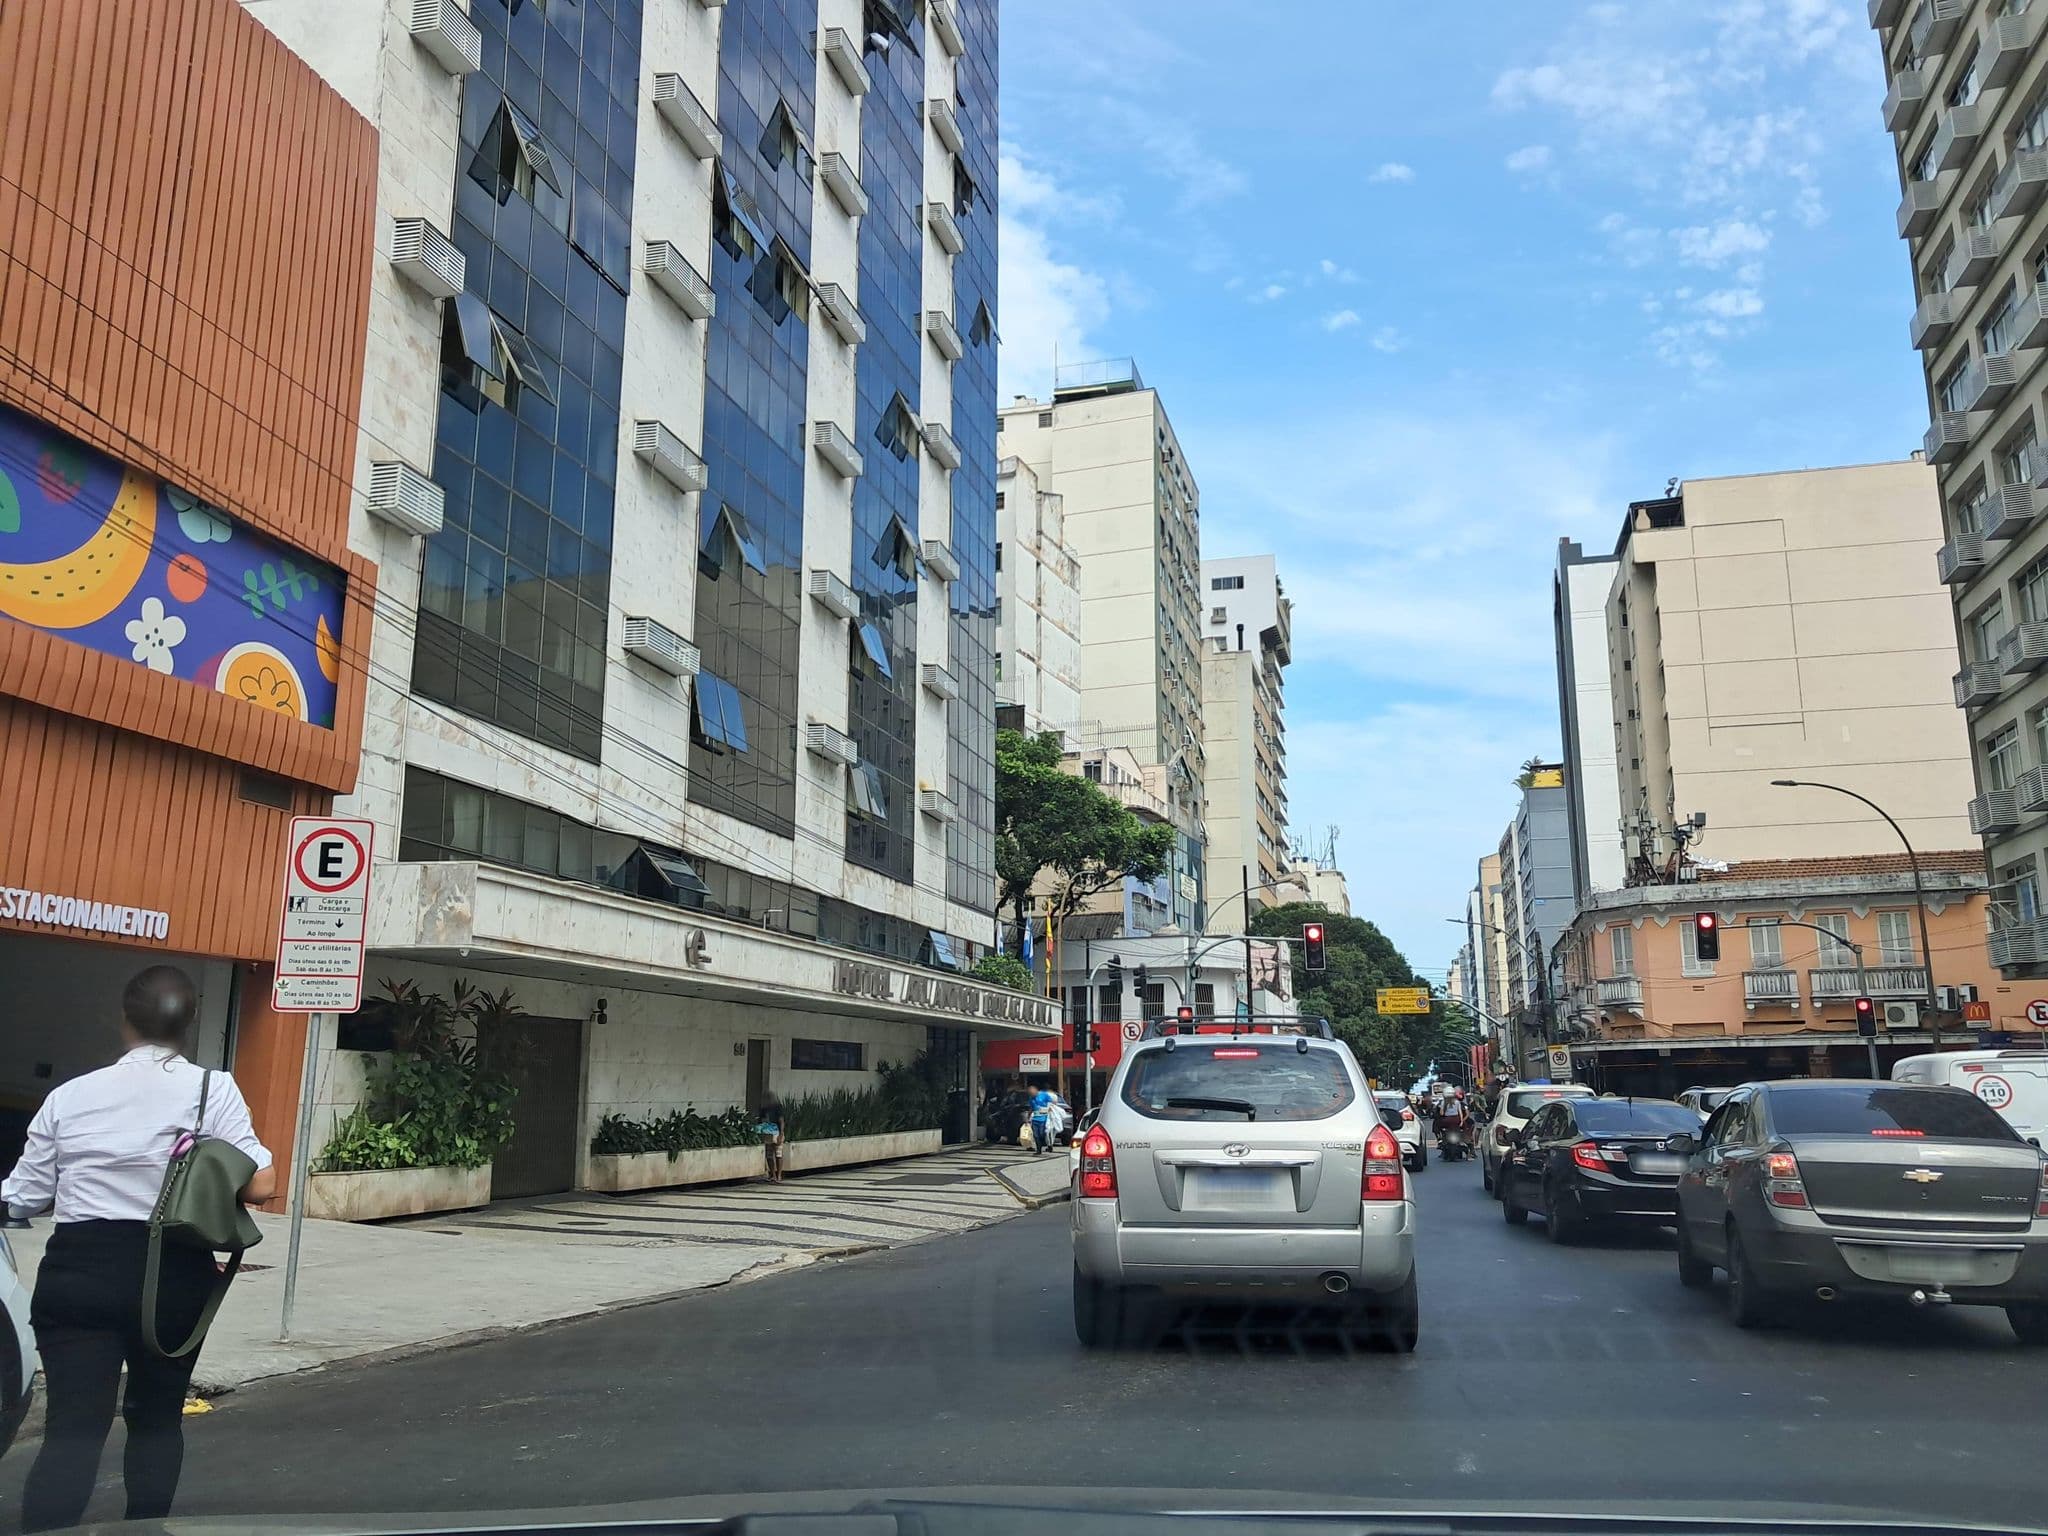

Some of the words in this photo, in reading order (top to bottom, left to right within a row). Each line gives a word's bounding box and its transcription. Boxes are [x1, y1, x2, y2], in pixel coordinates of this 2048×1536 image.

[318, 842, 344, 878] E
[322, 898, 343, 906] Carga
[2035, 1005, 2048, 1021] E
[1980, 1088, 2006, 1098] 110
[1116, 1141, 1151, 1149] HYUNDAI
